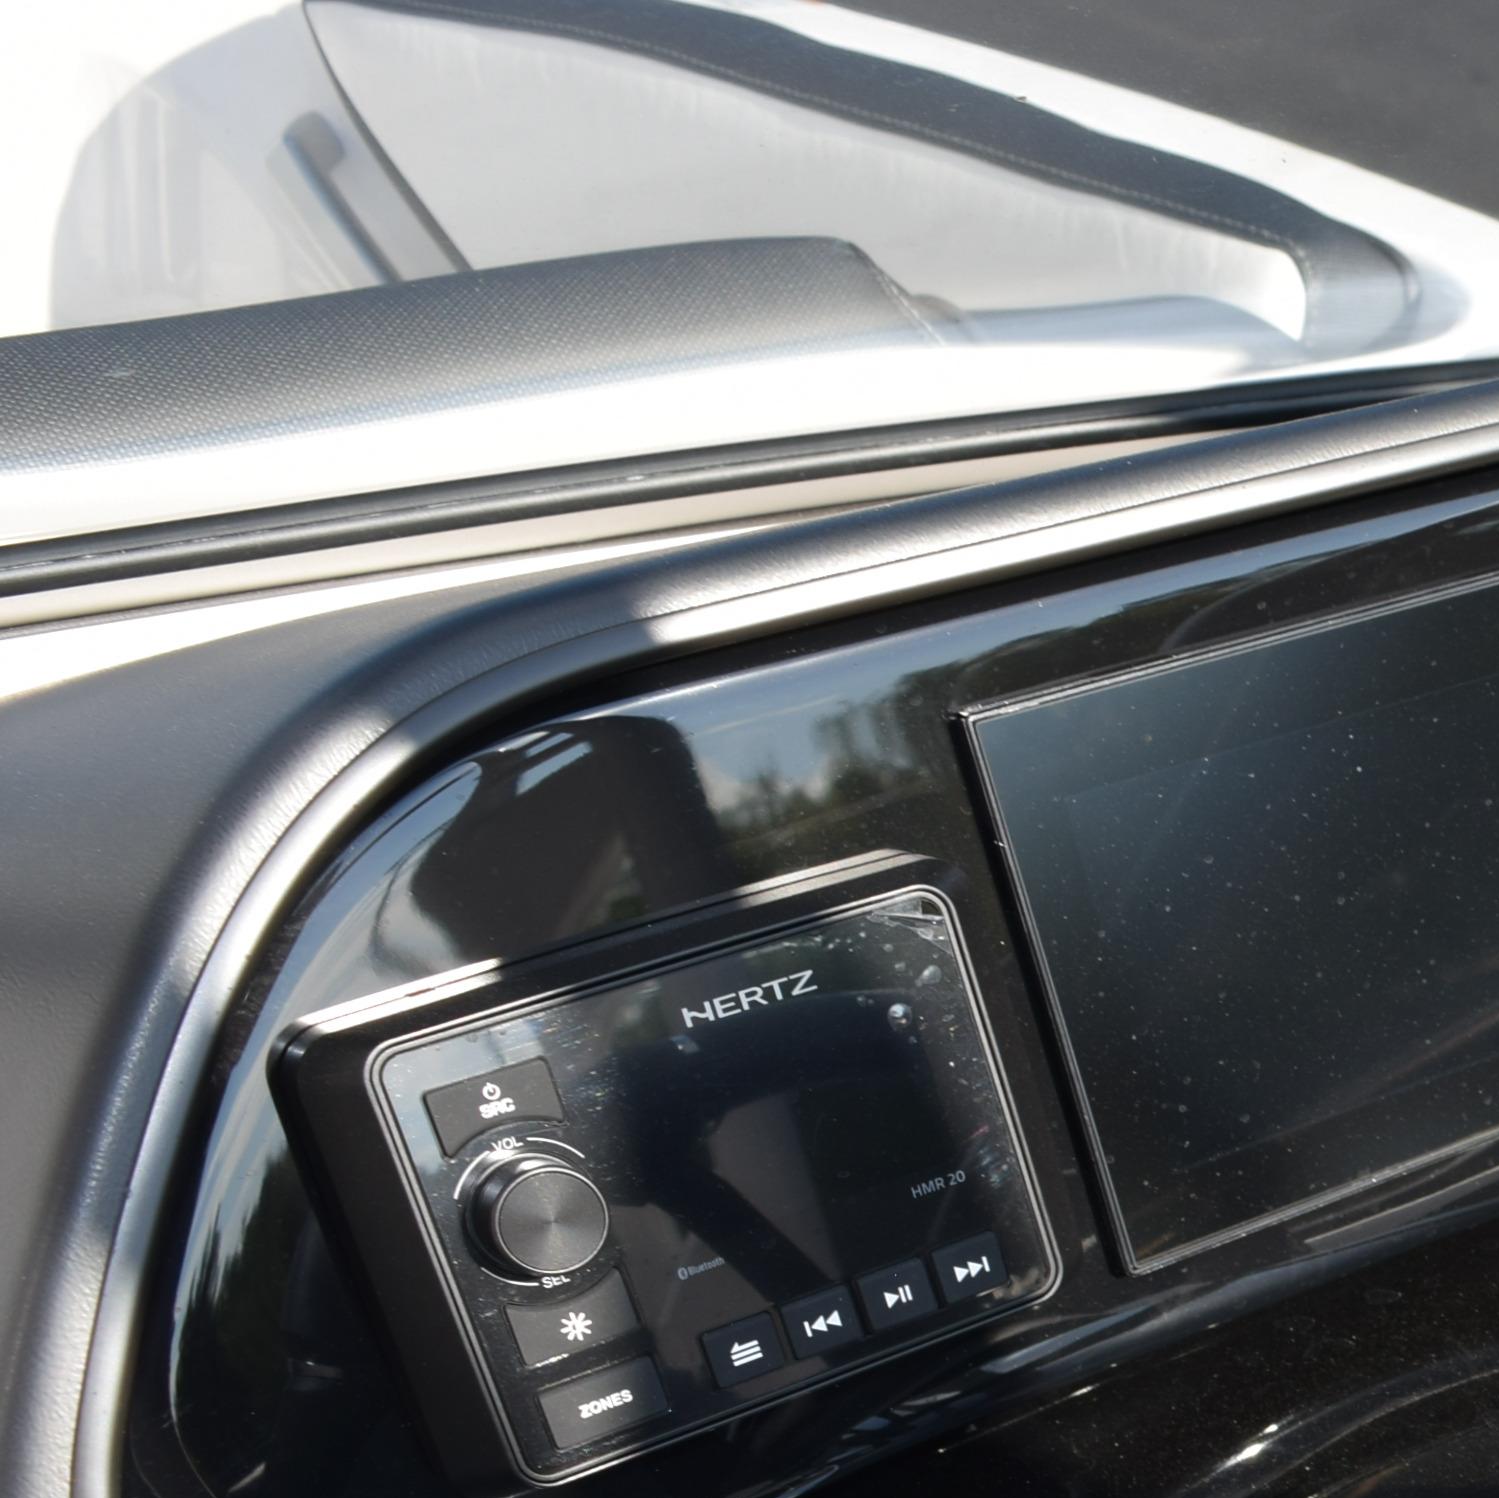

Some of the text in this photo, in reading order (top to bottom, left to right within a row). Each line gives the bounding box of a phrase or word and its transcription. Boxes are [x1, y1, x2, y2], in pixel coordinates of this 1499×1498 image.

[681, 969, 818, 1028] HERTZ
[479, 1097, 516, 1119] SRC
[491, 1136, 524, 1152] VOL
[911, 1170, 966, 1199] HMR 20
[541, 1274, 571, 1289] SEL
[578, 1389, 633, 1419] ZONES
